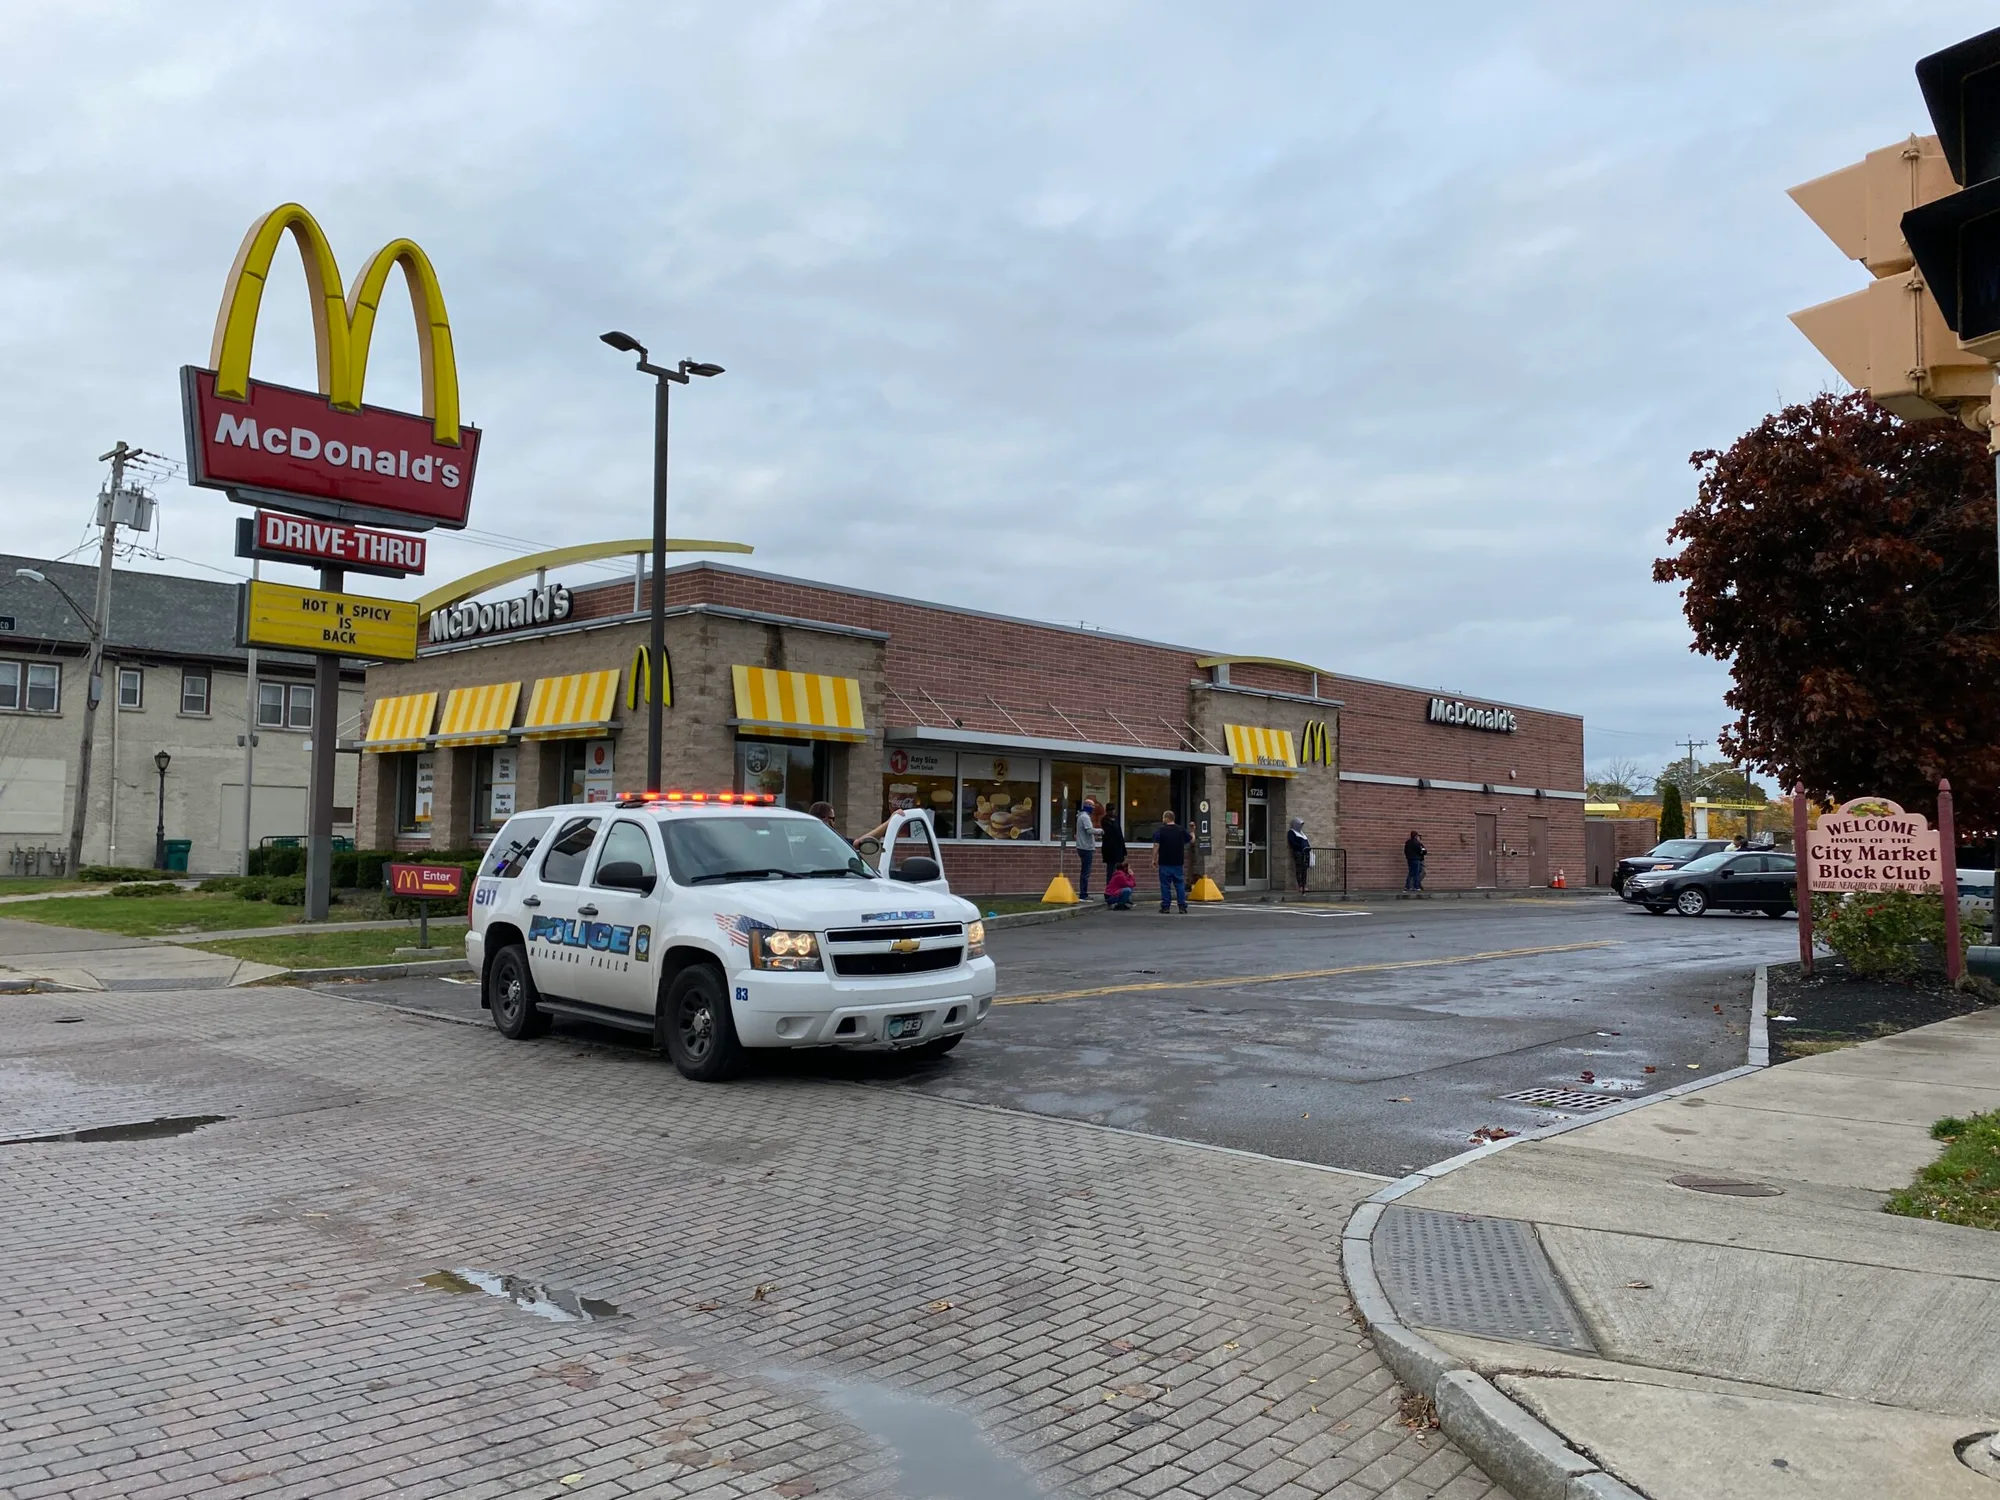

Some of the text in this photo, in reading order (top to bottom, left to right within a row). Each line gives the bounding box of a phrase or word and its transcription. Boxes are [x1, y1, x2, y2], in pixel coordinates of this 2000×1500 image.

[214, 413, 461, 489] McDonald's
[265, 517, 422, 568] DRIVE-THRU
[302, 598, 391, 621] HOT N SPICY
[428, 584, 572, 643] McDonald's
[340, 617, 352, 629] IS
[323, 629, 356, 644] BACK
[1429, 698, 1518, 732] McDonald's
[911, 756, 939, 764] Any Size
[1256, 755, 1288, 767] Welcome
[1826, 819, 1918, 837] WELCOME
[1811, 845, 1938, 863] City Market
[423, 870, 451, 881] Enter
[1819, 864, 1931, 880] Block Club
[1812, 880, 1836, 889] WHERE
[1839, 881, 1878, 891] NEIGHBORS
[475, 889, 497, 906] 911
[861, 910, 936, 924] POLICE
[528, 914, 634, 956] POLICE
[530, 947, 580, 964] NIAGARA
[590, 955, 629, 972] FALLS
[736, 987, 748, 1001] 83
[903, 1019, 922, 1031] 83
